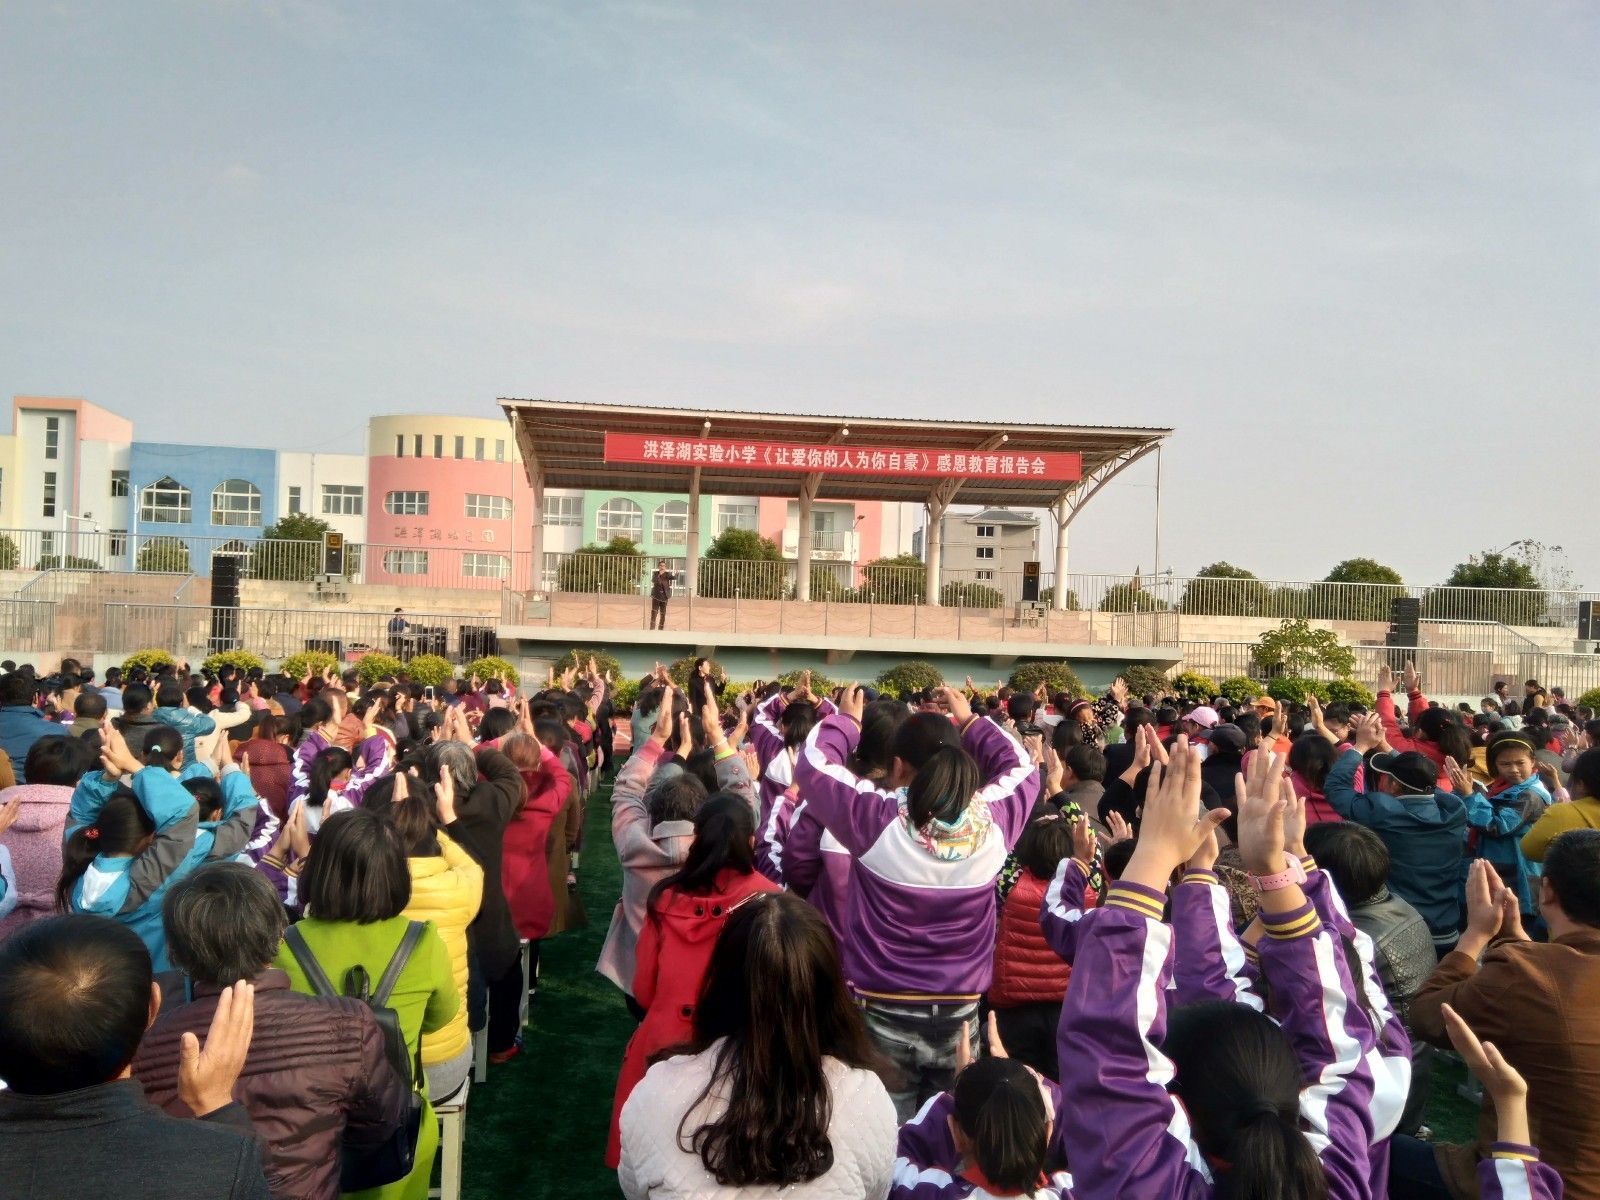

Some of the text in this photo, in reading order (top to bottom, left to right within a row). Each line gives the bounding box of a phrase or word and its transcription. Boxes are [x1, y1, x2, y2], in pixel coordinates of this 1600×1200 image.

[643, 440, 1046, 475] 洪泽湖实验小学《让爱你的人为你自豪》感恩教育报告会
